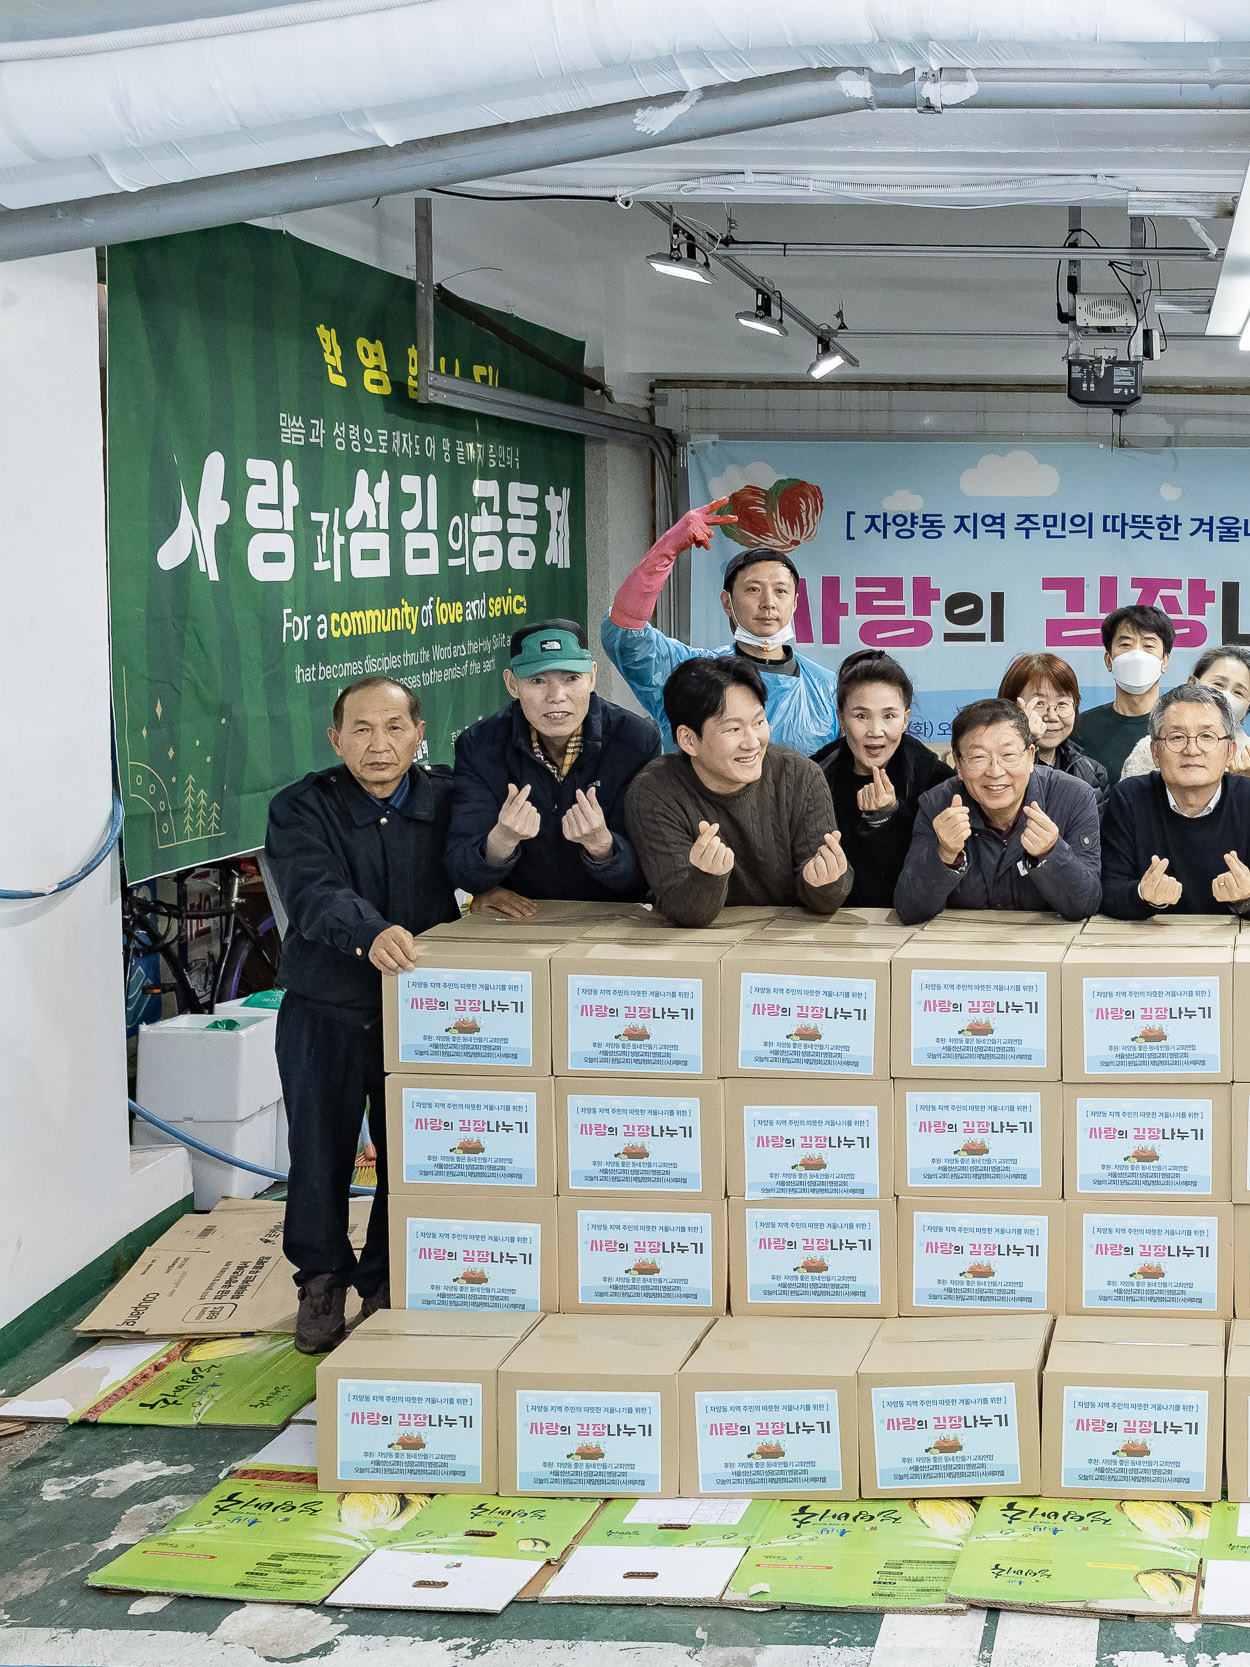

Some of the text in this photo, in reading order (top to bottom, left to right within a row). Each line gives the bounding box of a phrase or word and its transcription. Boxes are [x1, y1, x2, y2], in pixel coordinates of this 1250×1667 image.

[157, 451, 571, 582] 사랑과 섬김의 공동체
[864, 512, 945, 540] 자양동
[953, 512, 1005, 540] 지역
[1014, 512, 1093, 540] 주민의
[1102, 513, 1182, 541] 따뜻한
[283, 608, 311, 643] For
[317, 614, 328, 639] a
[331, 598, 419, 635] community
[421, 597, 433, 627] of
[436, 597, 463, 625] love
[466, 592, 486, 621] and
[794, 576, 1006, 648] 사랑의
[295, 665, 316, 683] that
[318, 662, 363, 680] becomes
[364, 652, 401, 673] disciples
[403, 649, 418, 667] thru
[420, 647, 430, 663] the
[432, 643, 452, 661] Word
[467, 640, 478, 654] the
[479, 635, 491, 653] Holy
[430, 667, 442, 684] the
[470, 660, 480, 676] the
[410, 997, 523, 1013] 사랑의 김장나누기
[752, 1003, 866, 1021] 사랑의 김장나누기
[923, 999, 1037, 1013] 사랑의 김장나누기
[579, 1123, 691, 1138] 사랑의 김장나누기
[1089, 1127, 1203, 1140] 사랑의 김장나누기
[756, 1135, 869, 1148] 사랑의 김장나누기
[590, 1239, 702, 1254] 사랑의 김장나누기
[925, 1241, 1038, 1257] 사랑의 김장나누기
[1095, 1243, 1208, 1258] 사랑의 김장나누기
[418, 1247, 531, 1265] 사랑의 김장나누기
[116, 1292, 160, 1327] coupang
[206, 1305, 225, 1321] eats
[350, 1411, 472, 1428] 사랑의 김장나누기
[709, 1421, 830, 1435] 사랑의 김장나누기
[886, 1414, 1008, 1431] 사랑의 김장나누기
[791, 1504, 902, 1528] 절임배추
[1000, 1501, 1112, 1525] 절임배추
